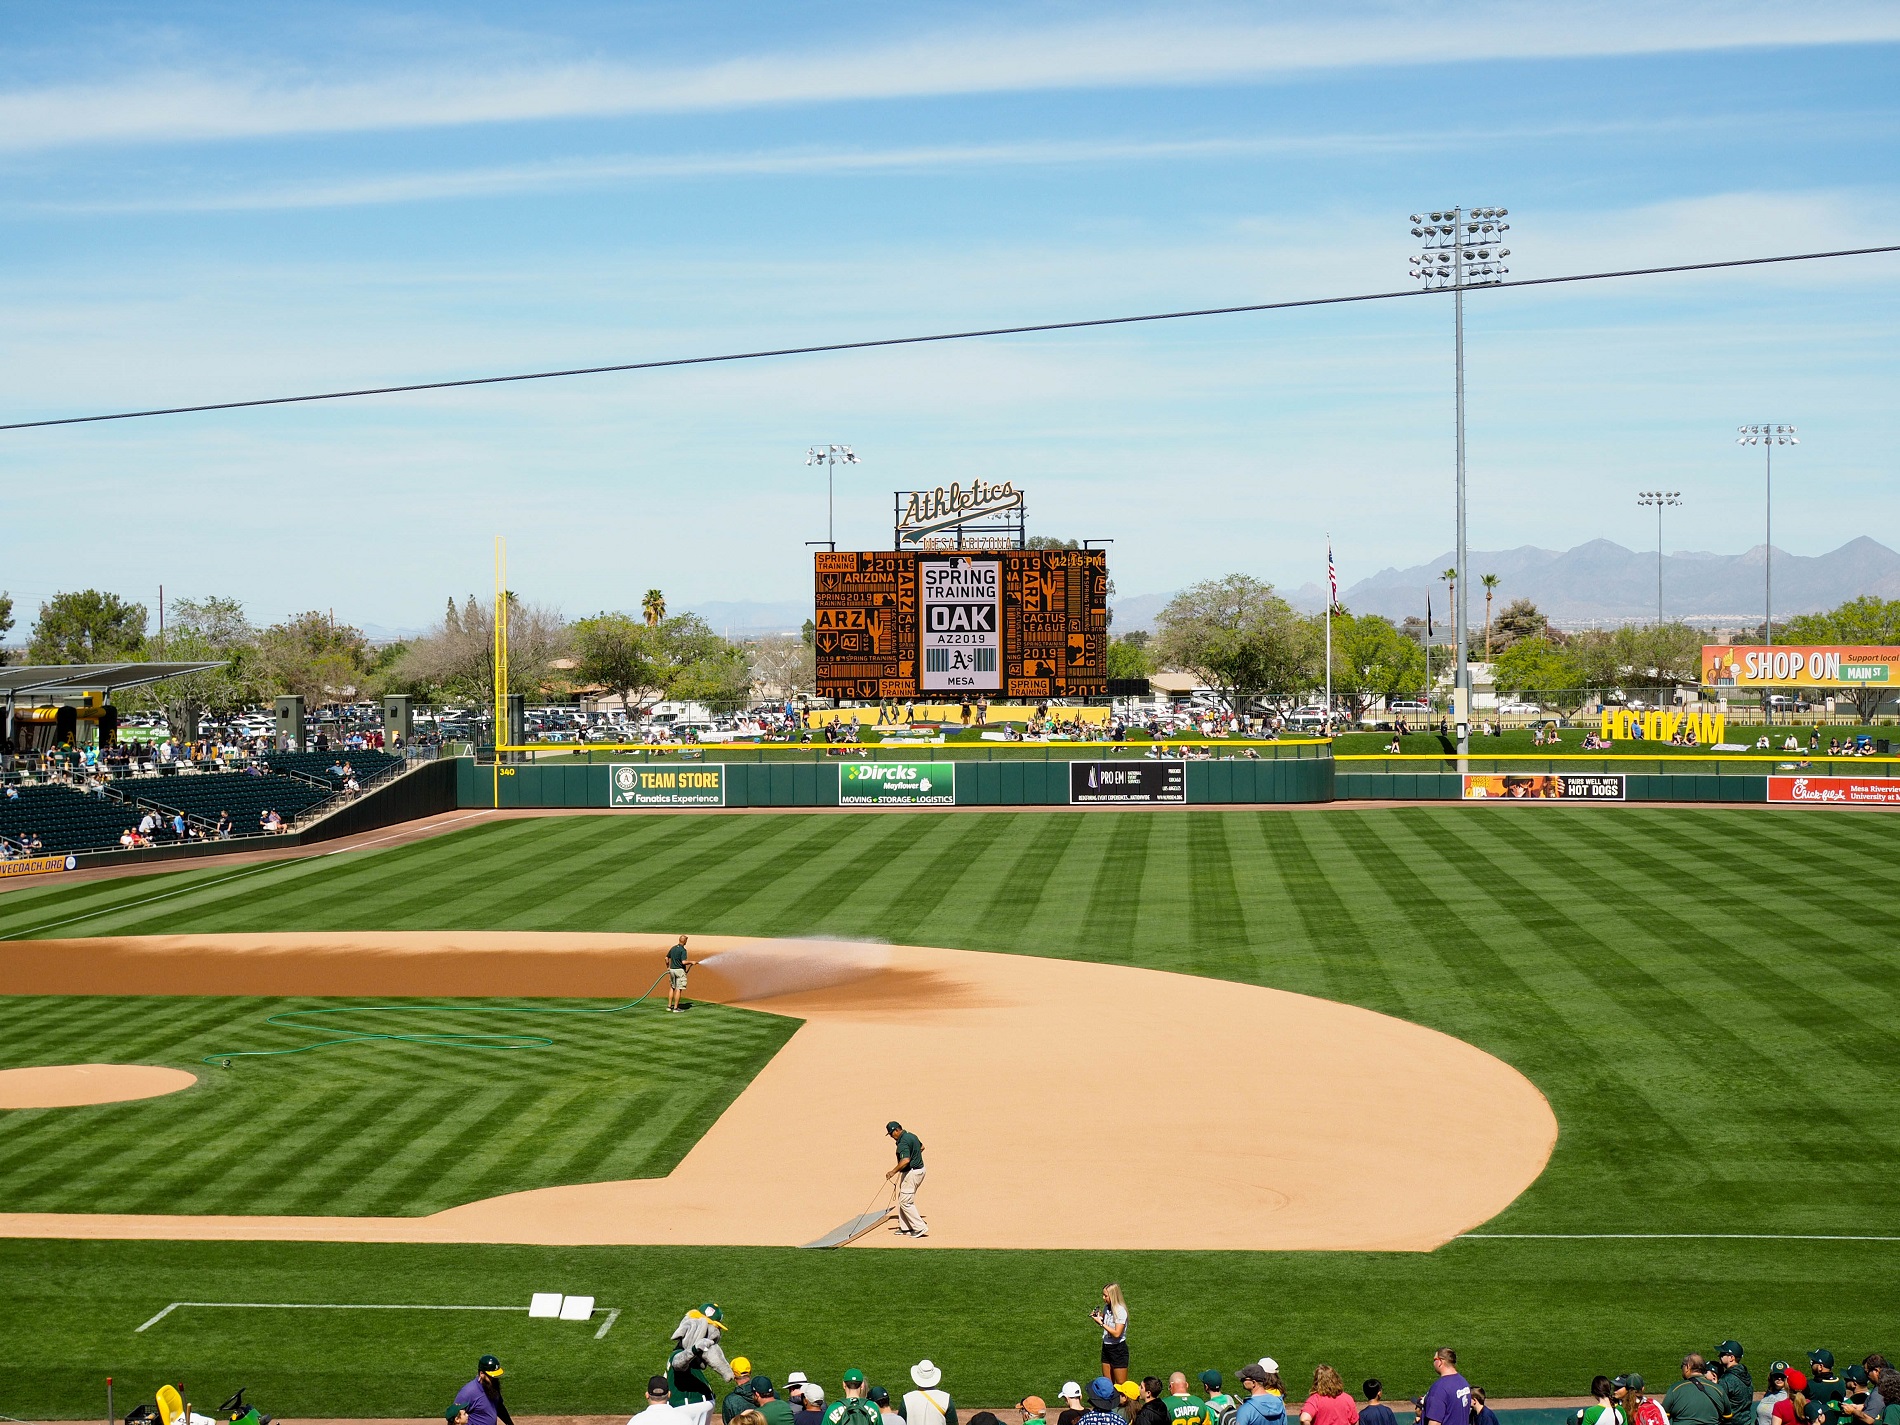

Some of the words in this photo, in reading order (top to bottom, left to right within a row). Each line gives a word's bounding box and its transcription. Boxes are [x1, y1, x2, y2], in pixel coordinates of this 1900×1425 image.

[898, 479, 1014, 530] Athletics
[923, 537, 956, 550] MESA
[961, 537, 1012, 550] ARIZONA
[818, 555, 854, 563] SPRING
[1006, 558, 1040, 570] 019
[844, 573, 895, 583] ARIZONA
[925, 569, 996, 585] SPRING
[816, 593, 846, 601] SPRING
[846, 593, 872, 601] 2019
[899, 574, 914, 611] ARZ
[926, 586, 996, 598] TRAINING
[1024, 573, 1039, 610] ARZ
[820, 611, 864, 628] ARZ
[931, 606, 991, 631] OAK
[1023, 613, 1066, 623] CACTUS
[1023, 623, 1065, 632] LEAGUE
[843, 637, 857, 647] AZ
[937, 634, 985, 644] AZ2019
[1023, 648, 1057, 659] 2019
[1085, 633, 1096, 667] 2019
[1847, 654, 1879, 663] Support
[1880, 654, 1900, 662] local
[819, 667, 829, 675] AZ
[1009, 665, 1020, 673] AZ
[1745, 652, 1804, 680] SHOP
[1808, 652, 1841, 680] ON
[1847, 667, 1872, 679] MAIN
[1872, 667, 1881, 677] ST
[947, 677, 975, 686] MESA
[1010, 680, 1047, 689] SPRING
[500, 768, 515, 776] 340
[857, 765, 918, 780] Dircks
[639, 772, 676, 789] TEAM
[678, 772, 719, 789] STORE
[1100, 771, 1114, 785] PRO
[1114, 771, 1124, 785] EM
[883, 782, 919, 791] Mayflower
[1472, 787, 1488, 797] IPA
[1568, 785, 1589, 796] HOT
[1592, 785, 1619, 796] DOGS
[1850, 785, 1869, 793] Mesa
[615, 795, 623, 803] A
[635, 794, 671, 803] Fanatics
[671, 794, 719, 804] Experience
[1850, 793, 1886, 802] University
[0, 859, 63, 874] VECOACH.ORG
[1173, 1405, 1200, 1418] CHAPPY
